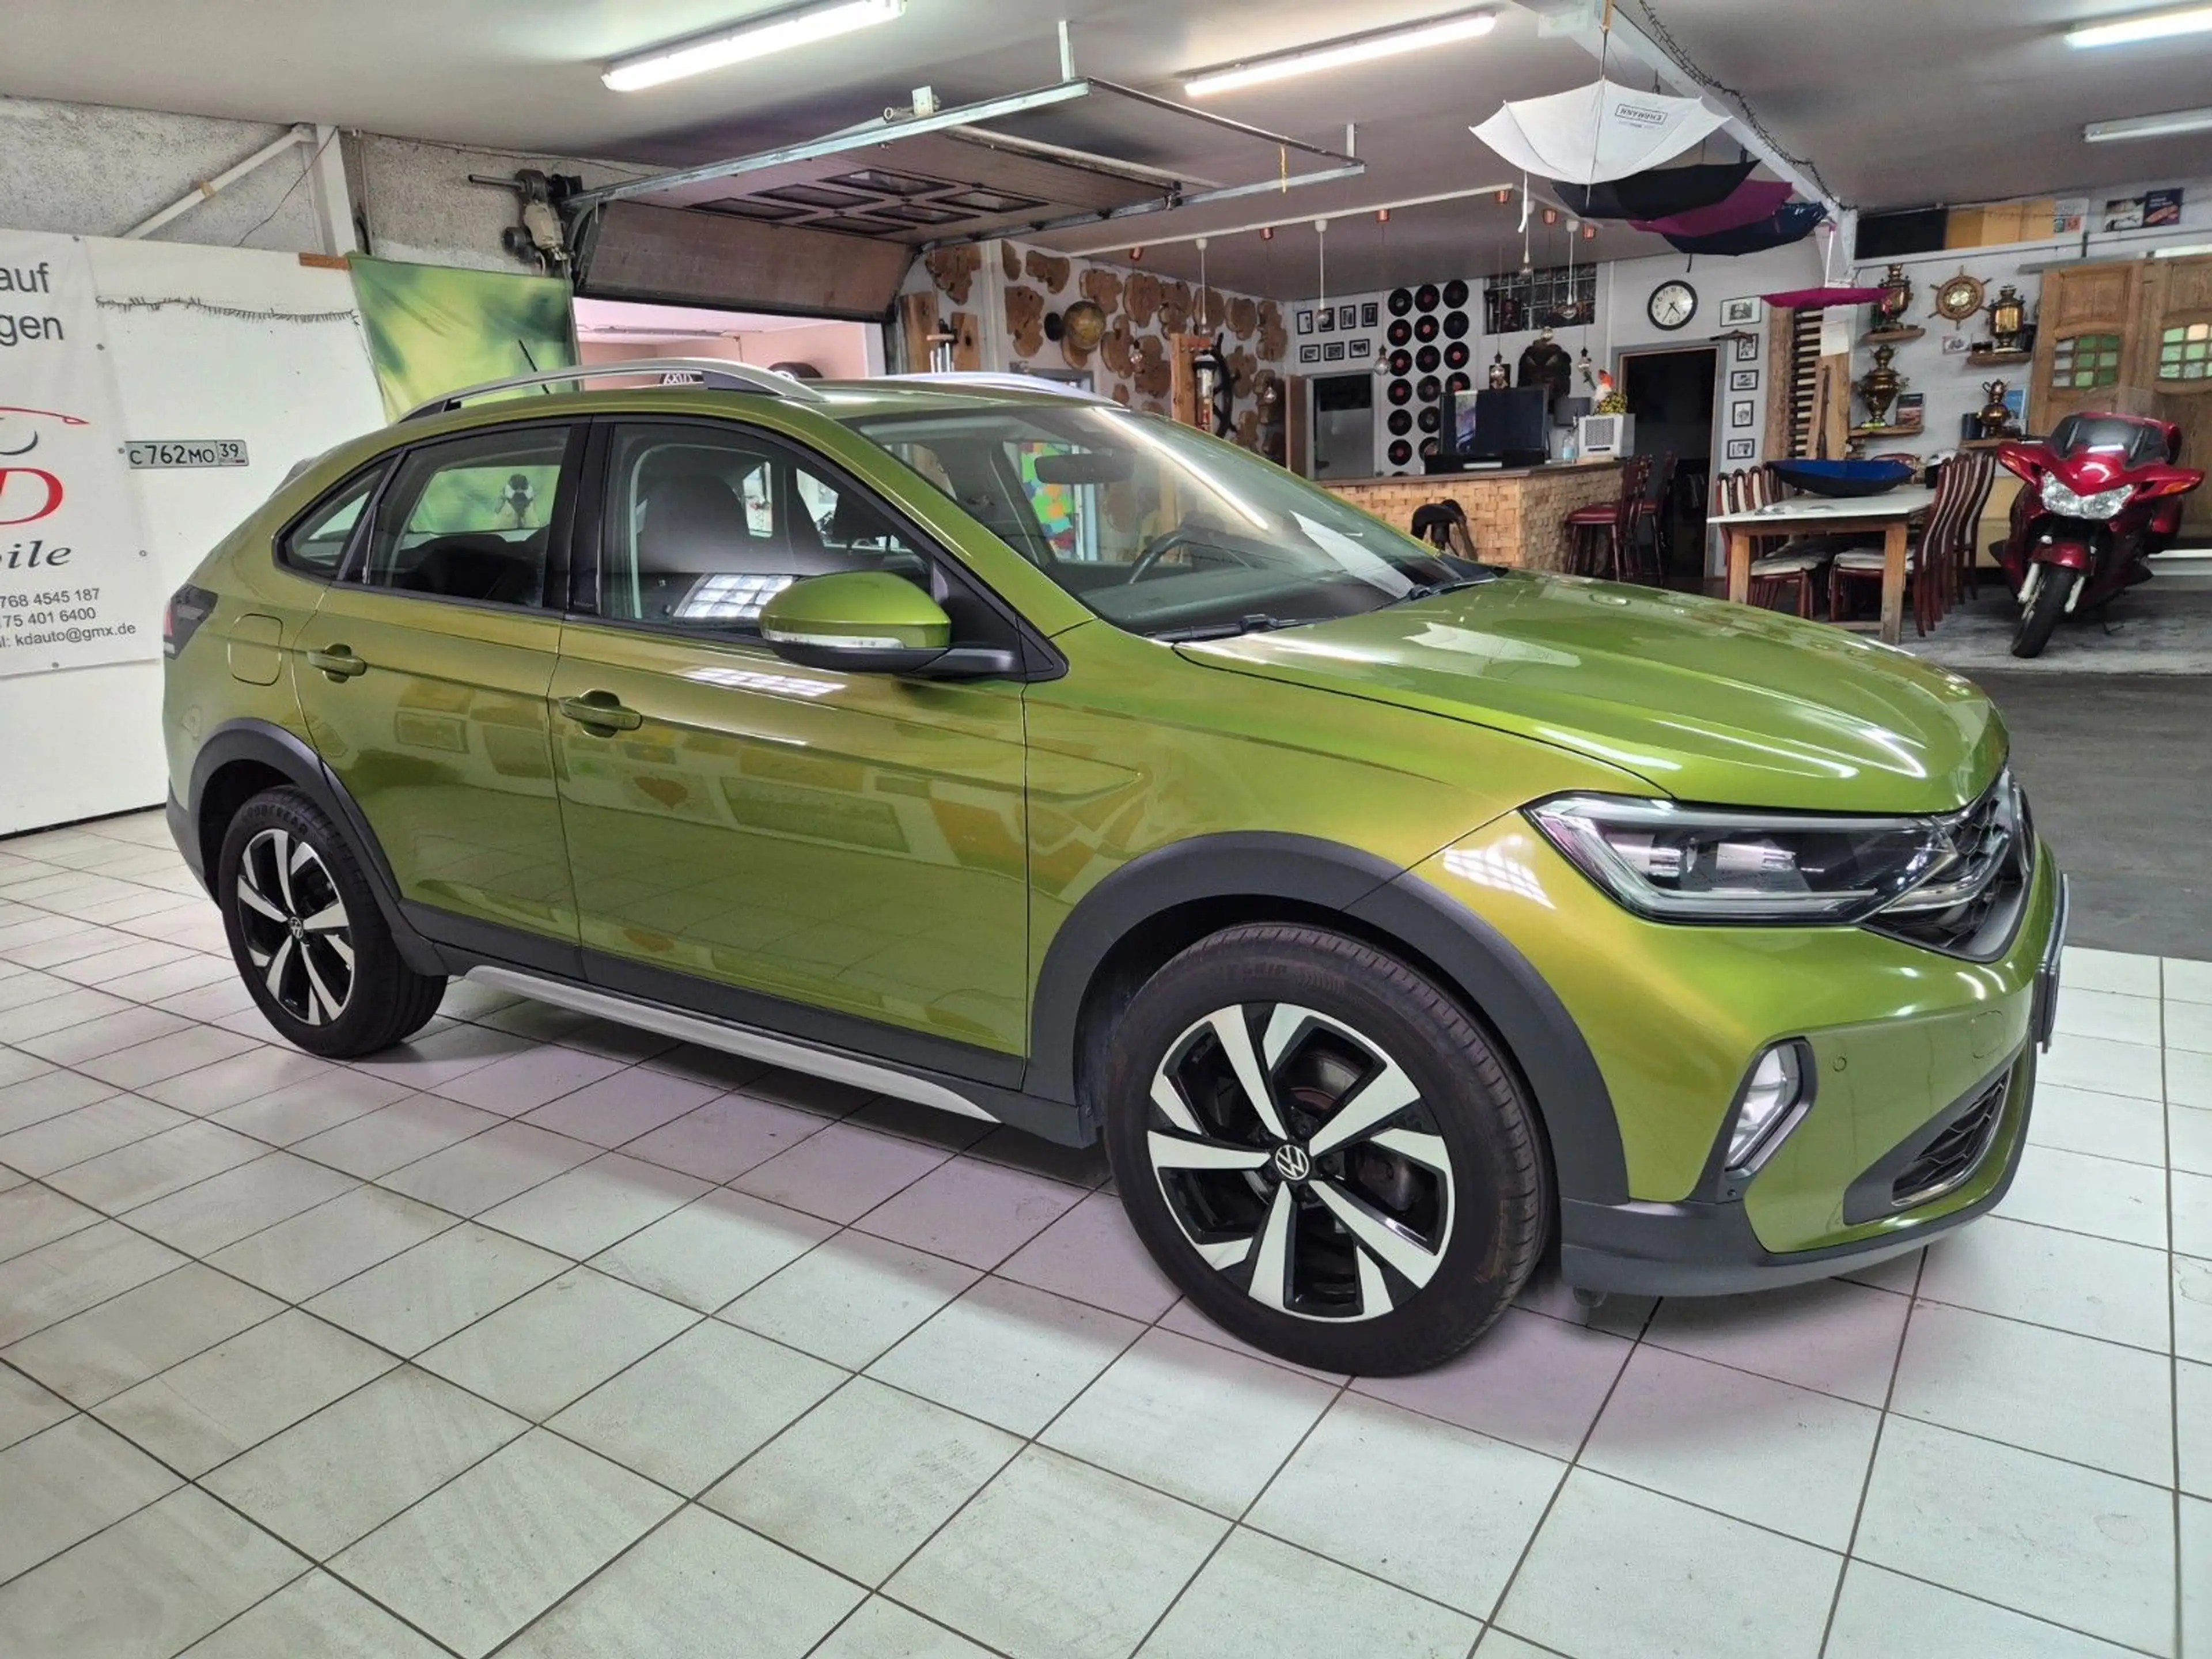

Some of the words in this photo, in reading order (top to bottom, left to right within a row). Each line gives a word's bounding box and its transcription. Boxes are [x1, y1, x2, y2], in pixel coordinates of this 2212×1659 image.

[219, 443, 238, 458] 39
[0, 540, 71, 569] ile
[33, 590, 70, 605] 4545
[75, 588, 100, 601] 187
[0, 614, 23, 628] 75
[28, 612, 54, 625] 401
[59, 607, 96, 622] 6400
[15, 622, 137, 647] kdauto@gmx.de
